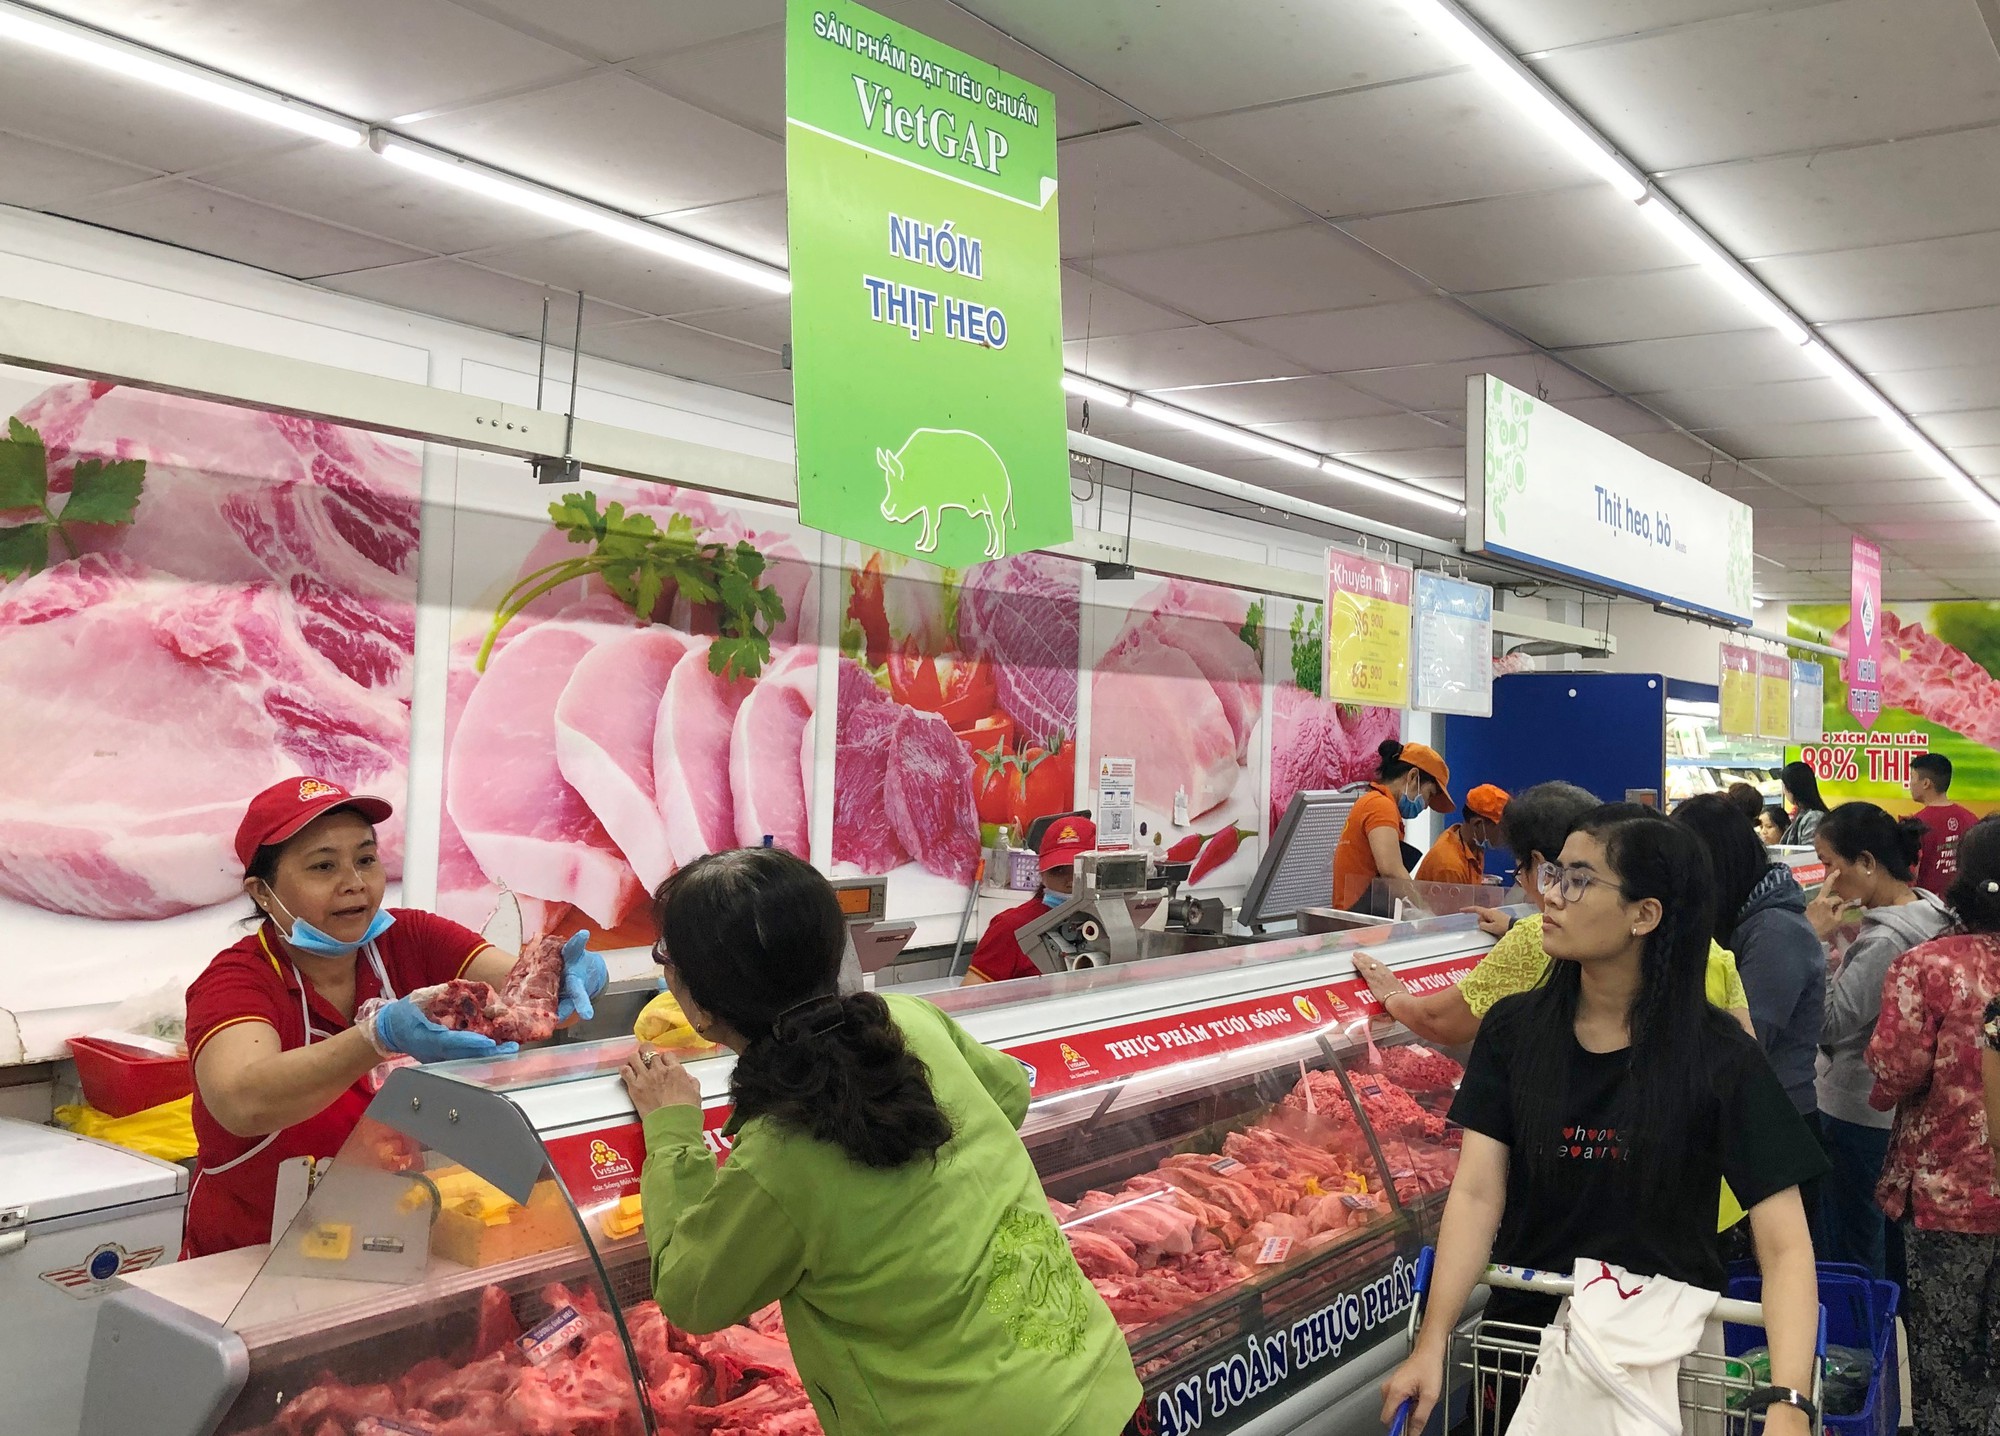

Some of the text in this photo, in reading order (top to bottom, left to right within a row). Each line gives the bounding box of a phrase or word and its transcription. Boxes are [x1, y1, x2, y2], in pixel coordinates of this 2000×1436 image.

[813, 12, 1038, 126] SẢN PHẨM ĐẠT TIÊU CHUẨN
[852, 74, 1009, 175] VietGAP
[889, 213, 982, 279] NHÓM
[864, 275, 1007, 349] THỊT HEO
[1595, 484, 1622, 537] Thịt
[1625, 497, 1653, 547] heo,
[1656, 511, 1671, 547] bò
[1334, 563, 1372, 592] Khuyến
[1803, 748, 1857, 781] 88%
[1832, 732, 1866, 744] XÍCH
[1105, 1008, 1291, 1060] THỰC PHẨM TƯƠI SỐNG
[597, 1164, 628, 1175] VISSAN
[1158, 1377, 1201, 1436] AN
[1208, 1332, 1288, 1416] TOÀN
[1291, 1293, 1360, 1369] THỰC
